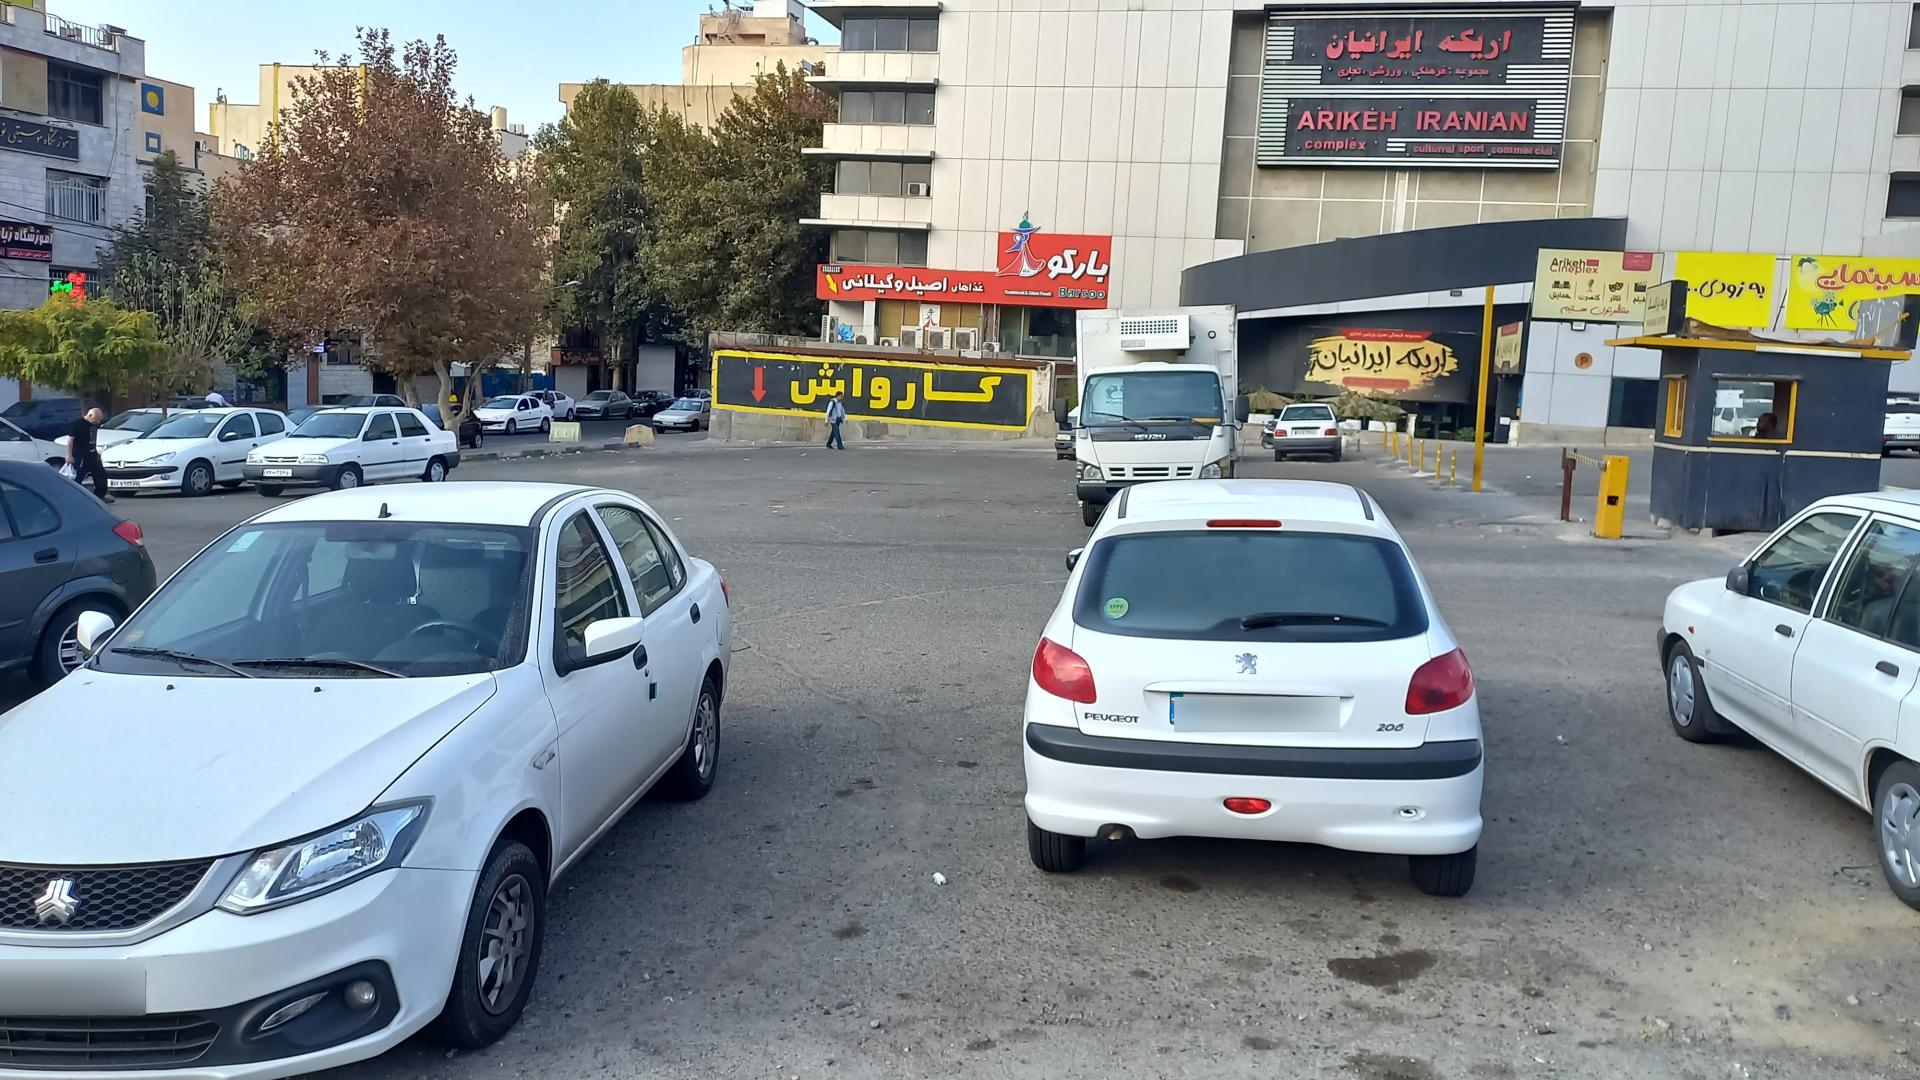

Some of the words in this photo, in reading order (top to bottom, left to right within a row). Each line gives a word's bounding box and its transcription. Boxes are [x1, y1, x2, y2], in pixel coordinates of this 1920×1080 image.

[1326, 29, 1423, 59] ایرانیان
[1438, 28, 1512, 60] اریکه
[1297, 110, 1398, 131] ARIKEH
[1415, 110, 1529, 132] IRANIAN
[1304, 137, 1367, 151] complex
[14, 227, 54, 246] آموزشگاه
[1047, 249, 1109, 283] بارکو
[1549, 264, 1599, 276] Cineplex
[1551, 257, 1586, 269] Arikeh
[842, 273, 894, 294] گیلانی
[906, 276, 948, 295] اصیل
[1059, 286, 1105, 299] Barcoo
[1748, 283, 1766, 300] به
[1316, 342, 1391, 374] ایرانیان
[1396, 345, 1447, 375] اریکه
[790, 362, 1002, 411] کارواش
[1084, 712, 1140, 724] PEUGEOT
[1376, 722, 1404, 732] 206
